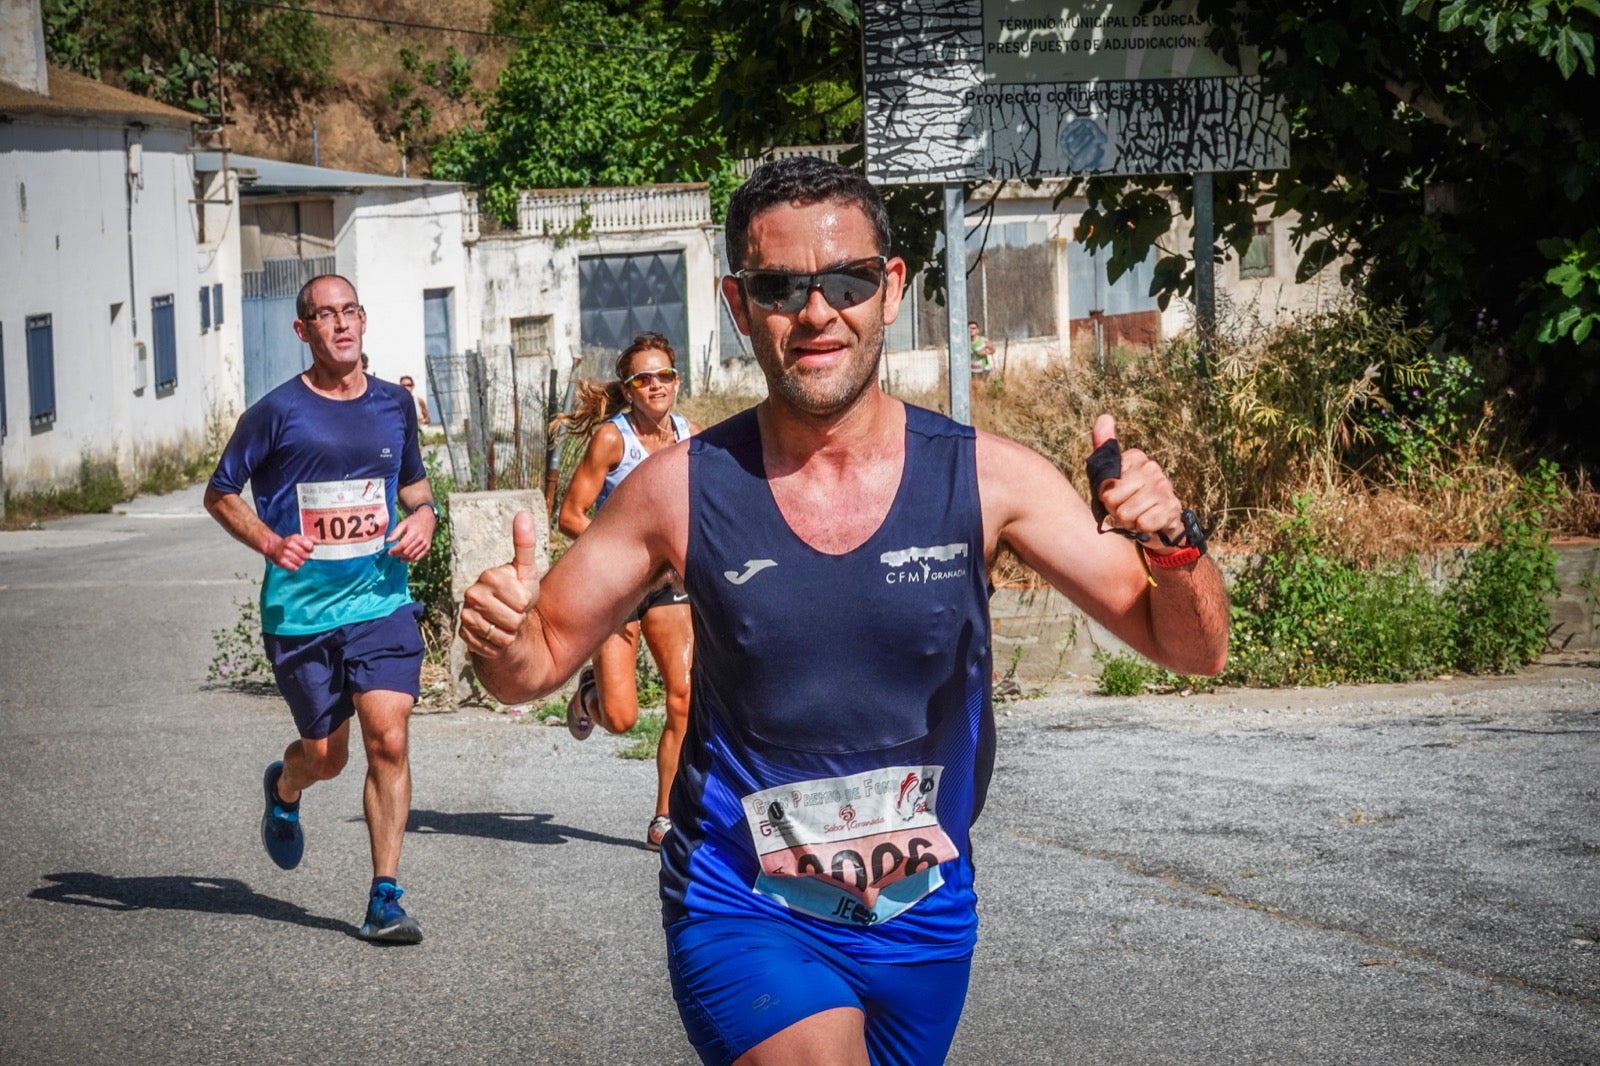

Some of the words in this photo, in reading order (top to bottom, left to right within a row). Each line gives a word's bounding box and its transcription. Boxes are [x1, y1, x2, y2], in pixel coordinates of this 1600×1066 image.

[998, 15, 1056, 30] TÉRMINO
[1060, 16, 1128, 29] MUNICIPAL
[1133, 15, 1149, 27] DE
[988, 41, 1080, 54] PRESUPUESTO
[1084, 39, 1100, 51] DE
[1104, 34, 1200, 50] ADJUDICACIÓN:
[964, 90, 1041, 108] Proyecto
[1047, 86, 1154, 103] cofinanciado
[314, 513, 380, 541] 1023
[931, 569, 967, 581] GRANADA
